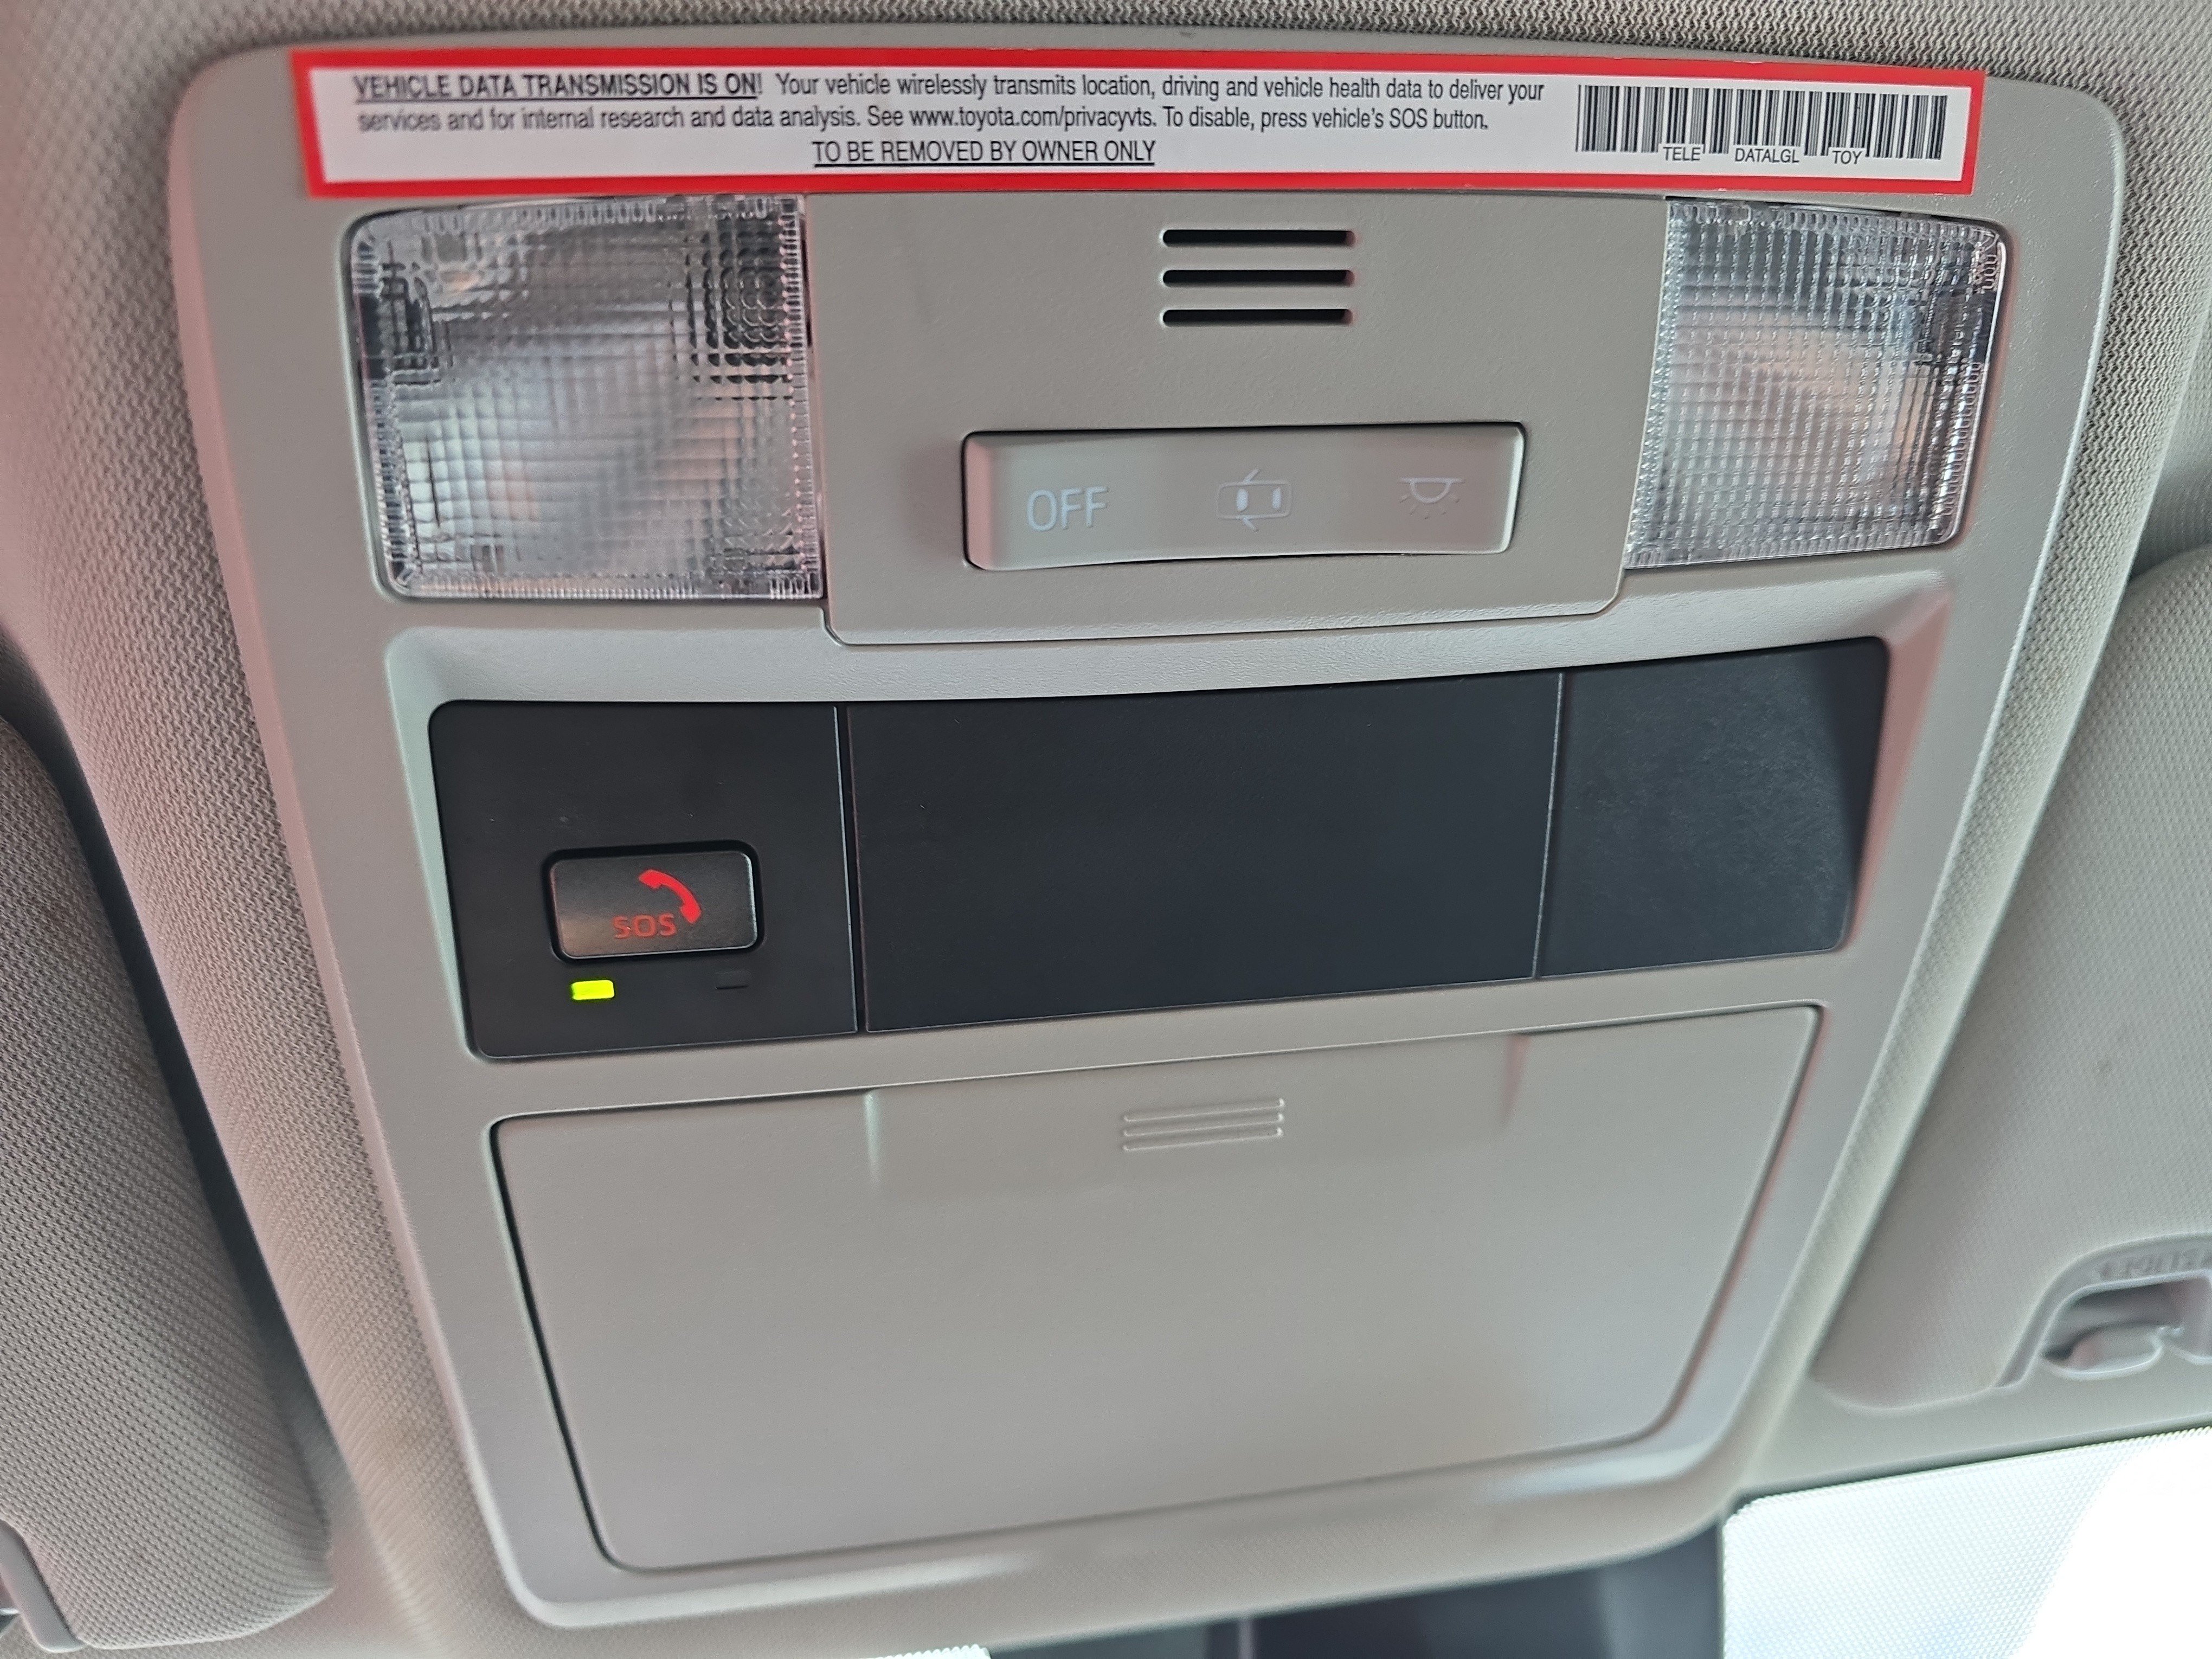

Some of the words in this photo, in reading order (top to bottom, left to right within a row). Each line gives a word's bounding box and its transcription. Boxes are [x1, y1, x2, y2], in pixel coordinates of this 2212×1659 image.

[353, 74, 451, 98] VEHICLE
[458, 74, 516, 98] DATA
[522, 73, 690, 97] TRANSMISSION
[697, 73, 717, 94] IS
[725, 73, 762, 94] ON!
[775, 73, 818, 94] Your
[825, 73, 890, 95] vehicle
[897, 73, 987, 100] wirelessly
[994, 74, 1076, 95] transmits
[1082, 74, 1155, 99] location,
[1162, 75, 1219, 101] driving
[1226, 76, 1258, 97] and
[1264, 77, 1323, 98] vehicle
[1329, 78, 1380, 98] health
[1386, 78, 1422, 99] data
[1428, 80, 1443, 99] to
[1449, 79, 1503, 100] deliver
[1508, 83, 1545, 105] your
[358, 109, 440, 131] services
[448, 108, 484, 130] and
[489, 107, 516, 130] for
[520, 107, 594, 129] internal
[601, 106, 684, 128] research
[691, 106, 725, 127] and
[732, 105, 773, 127] data
[780, 105, 861, 132] analysis.
[867, 105, 904, 126] See
[910, 106, 1157, 132] www.toyota.com/privacyvts.
[1162, 106, 1183, 127] To
[1189, 106, 1255, 131] disable,
[1261, 111, 1307, 132] press
[1313, 108, 1384, 128] vehicle's
[1390, 108, 1427, 129] SOS
[1433, 108, 1489, 129] button.
[812, 141, 840, 161] TO
[847, 141, 874, 162] BE
[881, 141, 983, 162] REMOVED
[991, 141, 1016, 161] BY
[1022, 141, 1098, 161] OWNER
[1104, 140, 1156, 161] ONLY
[1663, 146, 1700, 161] TELE
[1734, 148, 1799, 163] DATALGL
[1832, 150, 1862, 164] TOY
[1026, 486, 1109, 532] OFF
[612, 913, 677, 939] SOS
